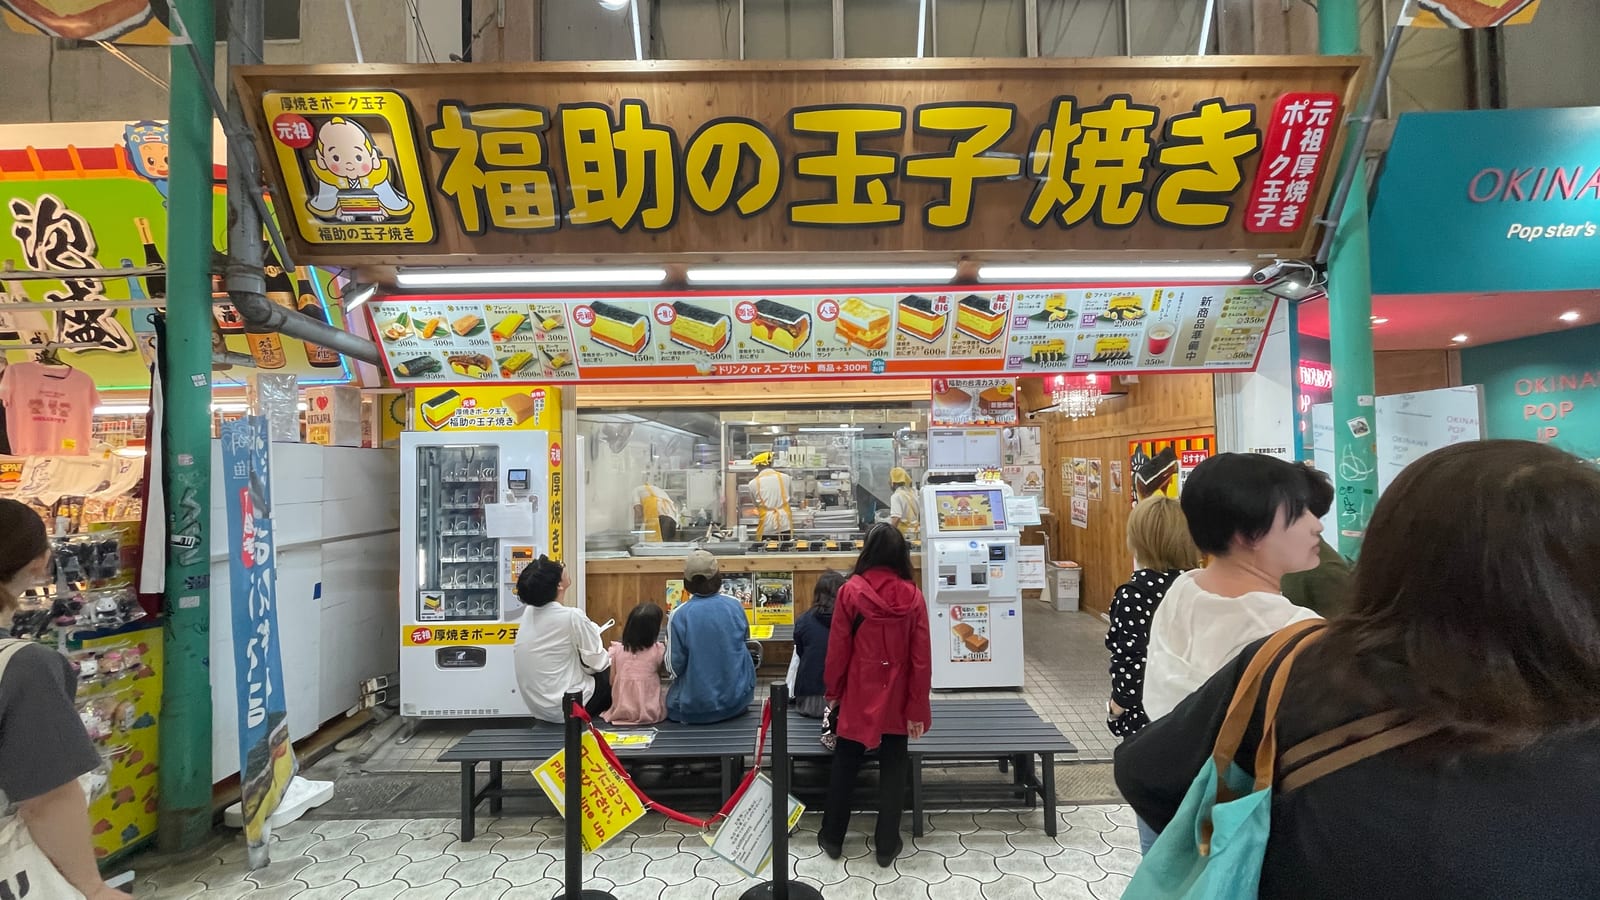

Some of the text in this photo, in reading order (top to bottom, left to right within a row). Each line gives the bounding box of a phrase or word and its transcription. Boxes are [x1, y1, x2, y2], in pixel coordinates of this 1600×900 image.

[280, 96, 387, 111] 厚焼きポーク玉子
[276, 122, 311, 140] 元祖
[429, 95, 1260, 235] 福助の玉子焼き
[1254, 99, 1310, 227] ポーク玉子
[1279, 101, 1333, 227] 元祖厚焼き
[318, 226, 415, 241] 福助の玉子焼き
[1507, 221, 1596, 242] Pop star's
[979, 347, 1002, 355] 650円
[718, 365, 748, 375] ドリンク
[764, 364, 811, 374] スープセット
[1515, 371, 1600, 397] OKINA
[308, 397, 314, 411] I
[455, 408, 508, 416] 厚焼きポーク玉子
[1523, 400, 1575, 421] POP
[449, 417, 514, 427] 福助の玉子焼き
[1182, 454, 1206, 464] おすすめ
[412, 628, 432, 641] 元祖
[581, 745, 632, 816] ロープに沿って
[593, 820, 606, 842] up.
